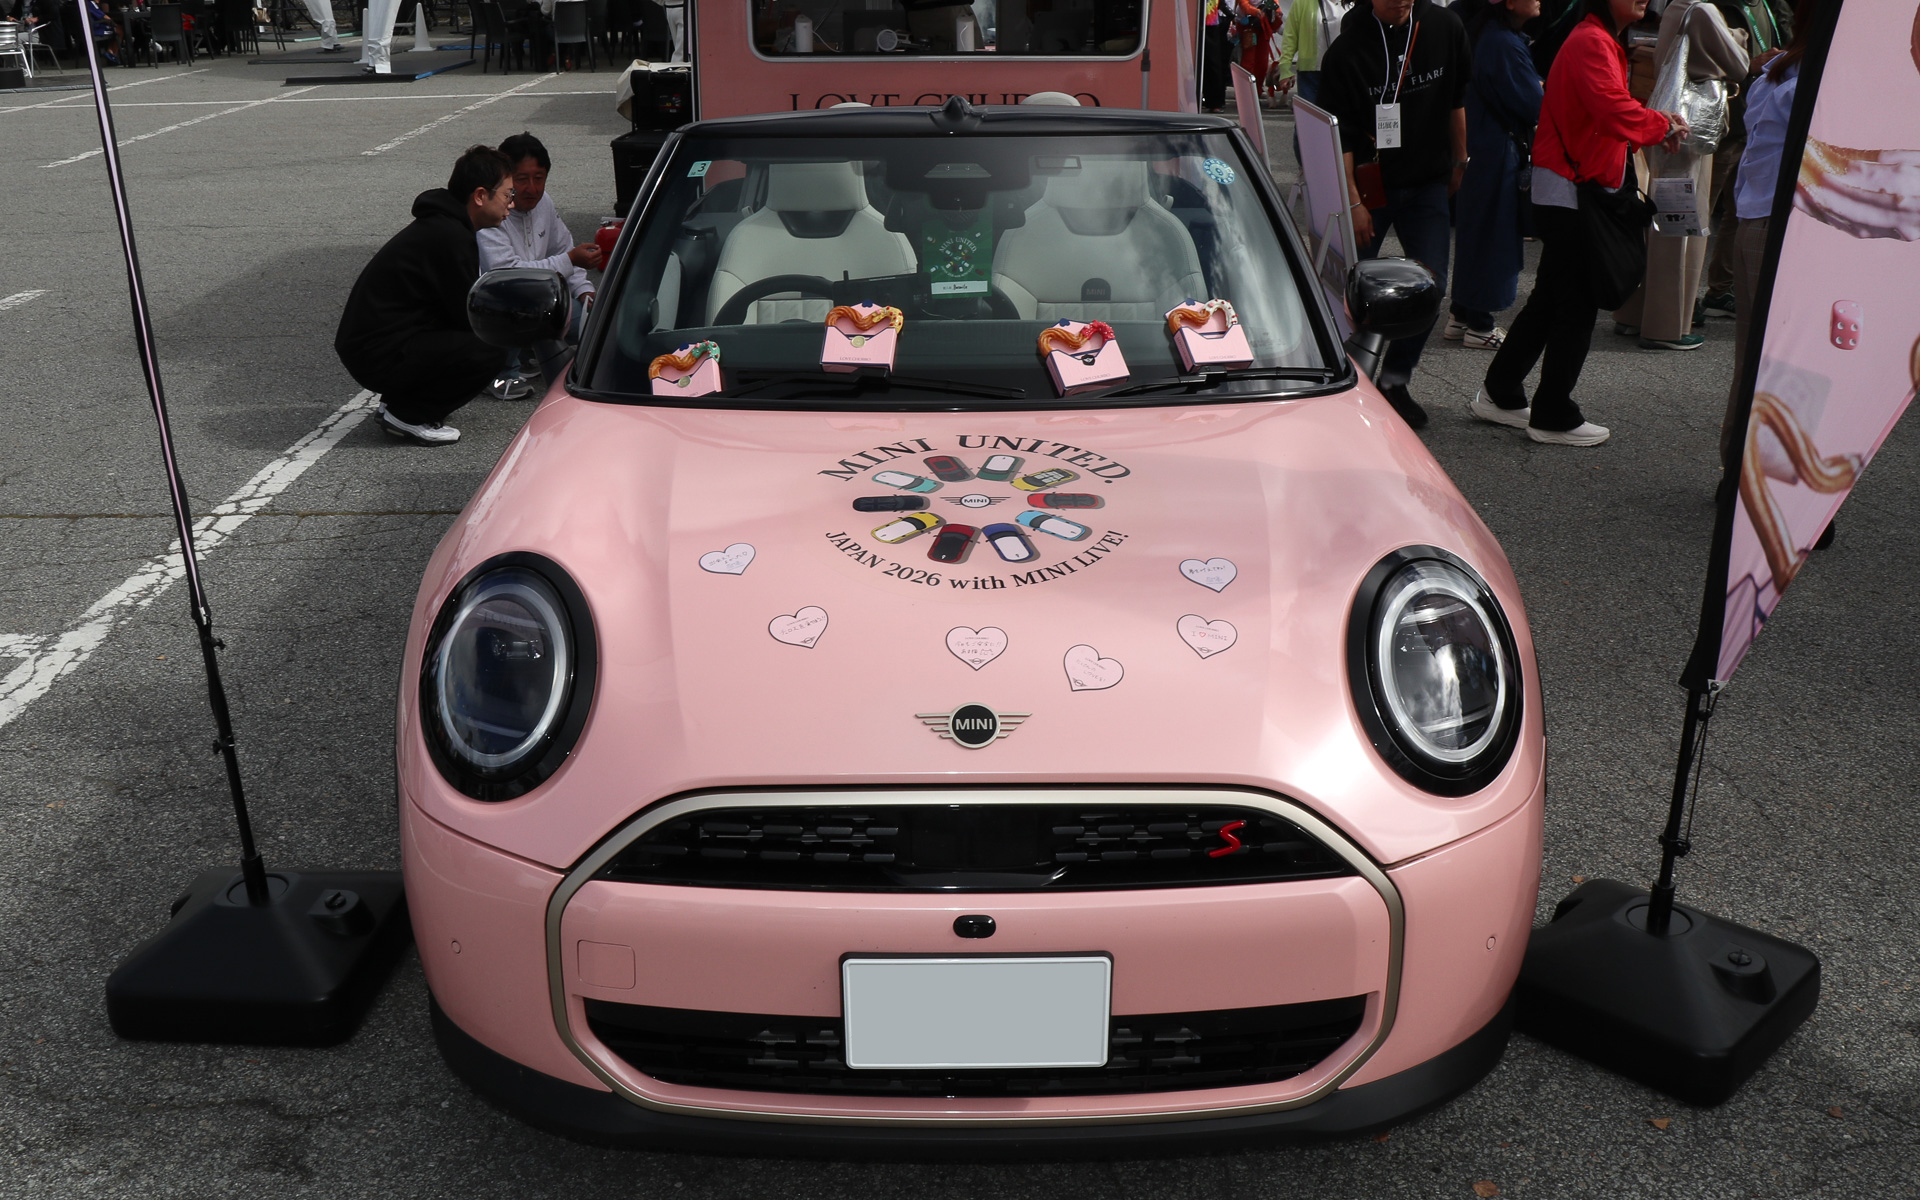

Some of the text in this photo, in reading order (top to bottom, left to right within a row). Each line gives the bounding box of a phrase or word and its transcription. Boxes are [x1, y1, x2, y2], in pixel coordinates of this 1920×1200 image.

[939, 238, 954, 253] MINI
[817, 437, 938, 481] MINI
[825, 530, 1129, 589] JAPAN 2026 with MINI LIVE!
[955, 718, 993, 730] MINI
[1208, 820, 1246, 858] S
